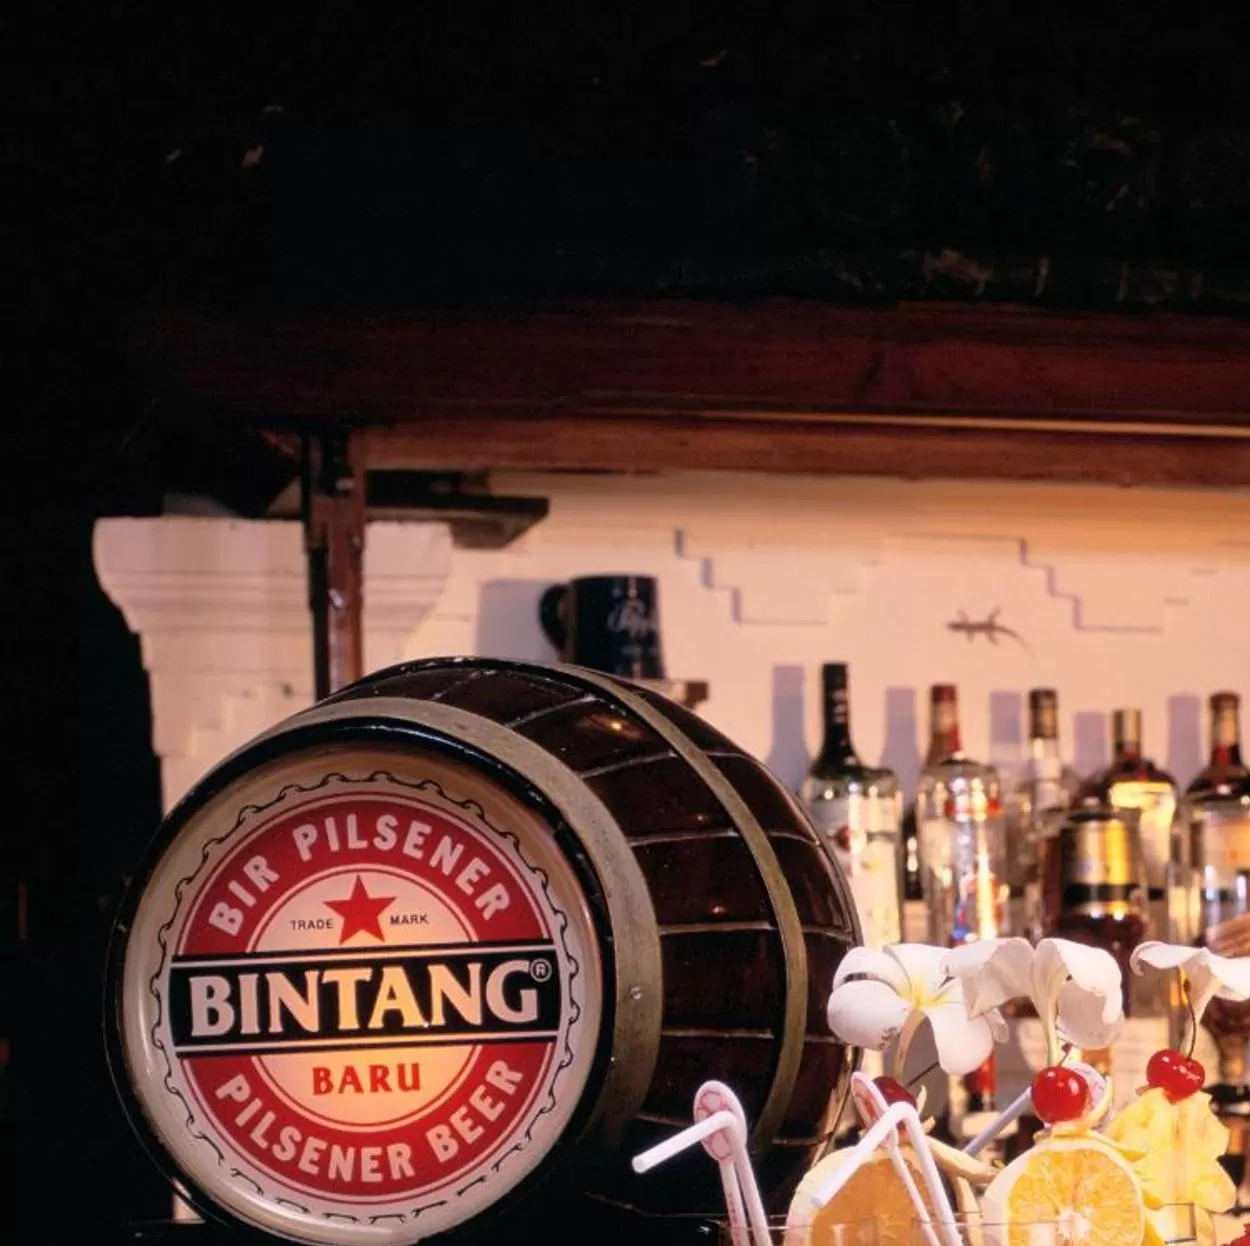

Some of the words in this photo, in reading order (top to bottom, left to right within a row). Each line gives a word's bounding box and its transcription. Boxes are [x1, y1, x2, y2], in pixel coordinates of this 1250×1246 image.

[208, 855, 280, 936] BIR
[292, 813, 511, 920] PILSENER
[290, 918, 334, 932] TRADE
[390, 912, 430, 926] MARK
[312, 1062, 422, 1096] BARU
[215, 1073, 415, 1183] PILSENER
[425, 1059, 524, 1163] BEER
